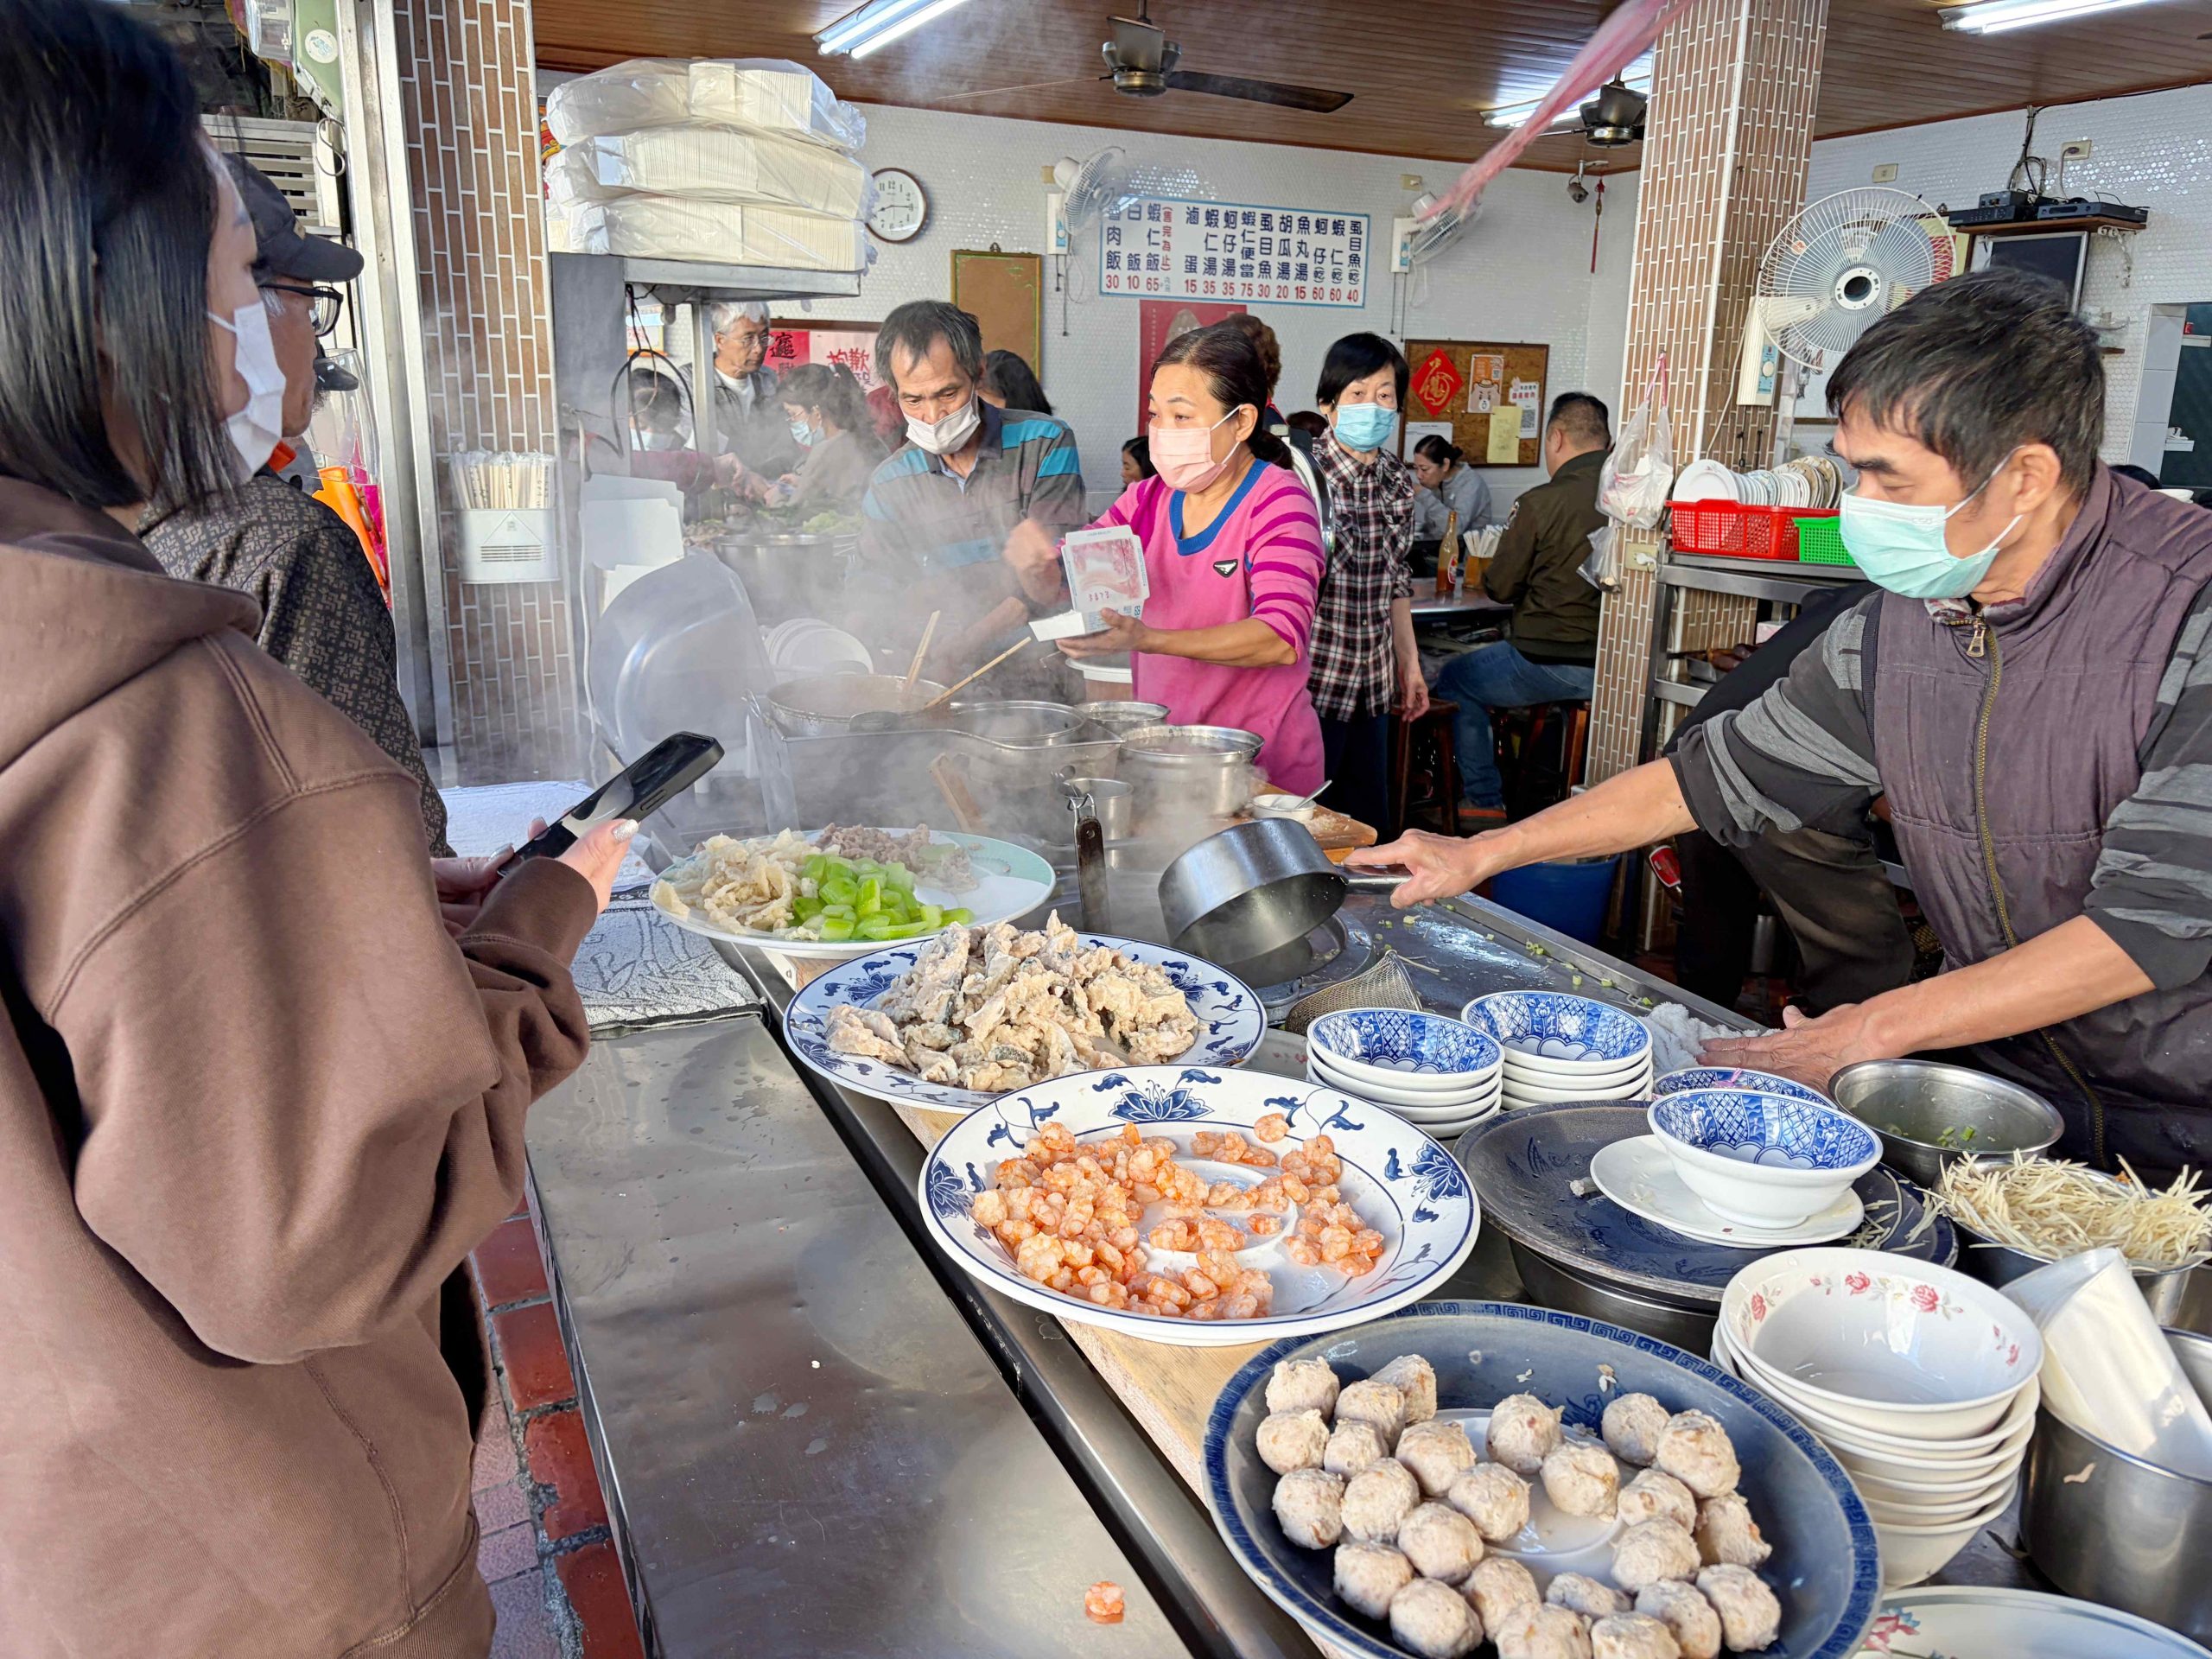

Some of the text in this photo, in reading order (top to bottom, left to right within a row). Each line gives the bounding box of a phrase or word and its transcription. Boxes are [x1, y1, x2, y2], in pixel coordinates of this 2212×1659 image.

[1106, 274, 1120, 289] 30
[1127, 275, 1140, 289] 10
[1146, 202, 1161, 291] 蝦仁飯 65
[1184, 206, 1199, 293] 滷蛋 15
[1203, 208, 1219, 295] 蝦仁湯 35
[1221, 210, 1238, 296] 蚵仔湯 35
[1240, 211, 1255, 297] 蝦仁便當 75
[1276, 214, 1293, 299] 胡瓜湯 20
[1294, 216, 1310, 300] 魚丸湯 15
[1257, 283, 1270, 298] 30
[1313, 287, 1325, 301] 60
[1330, 288, 1342, 302] 60
[1347, 289, 1359, 302] 40
